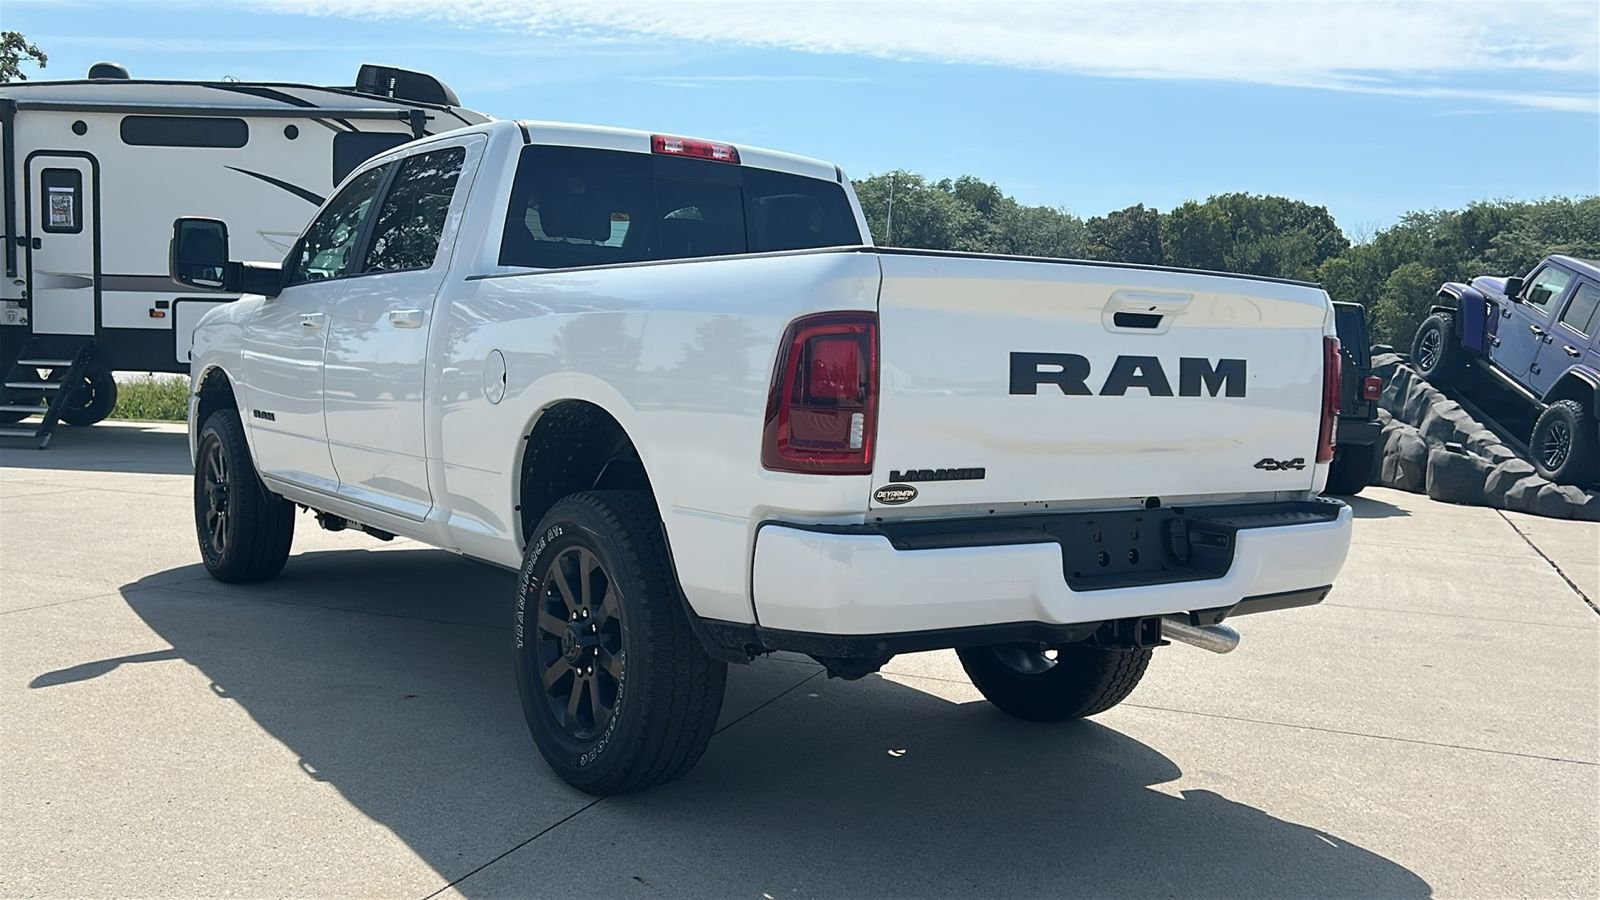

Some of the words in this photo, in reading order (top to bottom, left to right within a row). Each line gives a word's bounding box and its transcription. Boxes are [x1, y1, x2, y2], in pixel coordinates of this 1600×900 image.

[1009, 351, 1247, 398] RAM
[877, 490, 915, 498] DEYARMAN
[517, 536, 547, 649] TRANSFORCE
